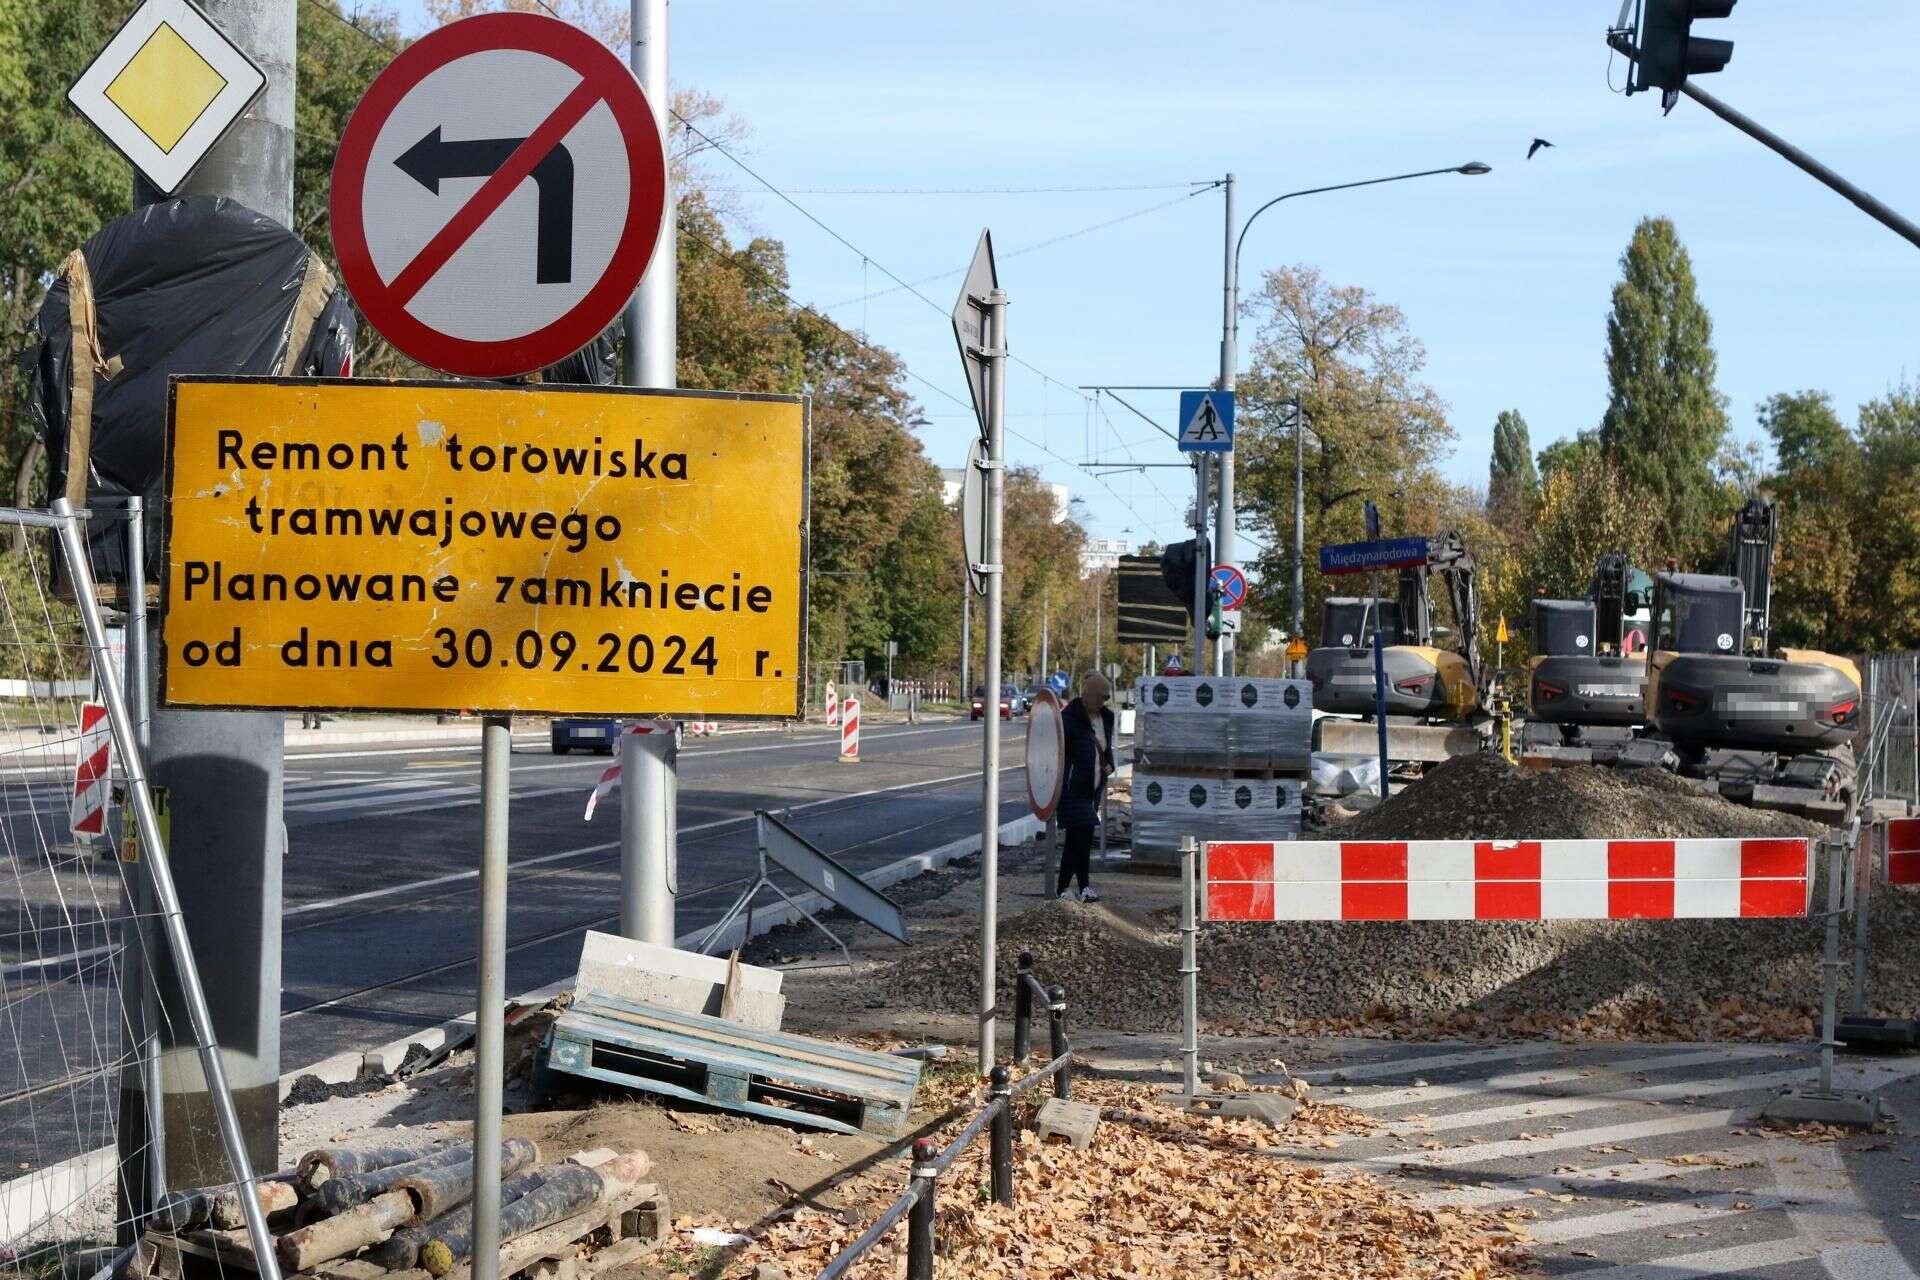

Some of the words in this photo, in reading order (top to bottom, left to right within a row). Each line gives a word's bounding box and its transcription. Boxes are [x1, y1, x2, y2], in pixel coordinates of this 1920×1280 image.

[218, 429, 409, 471] Remont
[445, 433, 688, 480] torowiska
[245, 496, 622, 555] tramwajowego
[1329, 547, 1418, 566] Międzynarodowa
[184, 561, 459, 603] Planowane
[495, 568, 773, 613] zamkniecie
[182, 626, 241, 668] od
[281, 627, 393, 668] dnia
[431, 627, 719, 676] 30.09.2024
[755, 650, 783, 678] r.
[1720, 636, 1731, 647] 25
